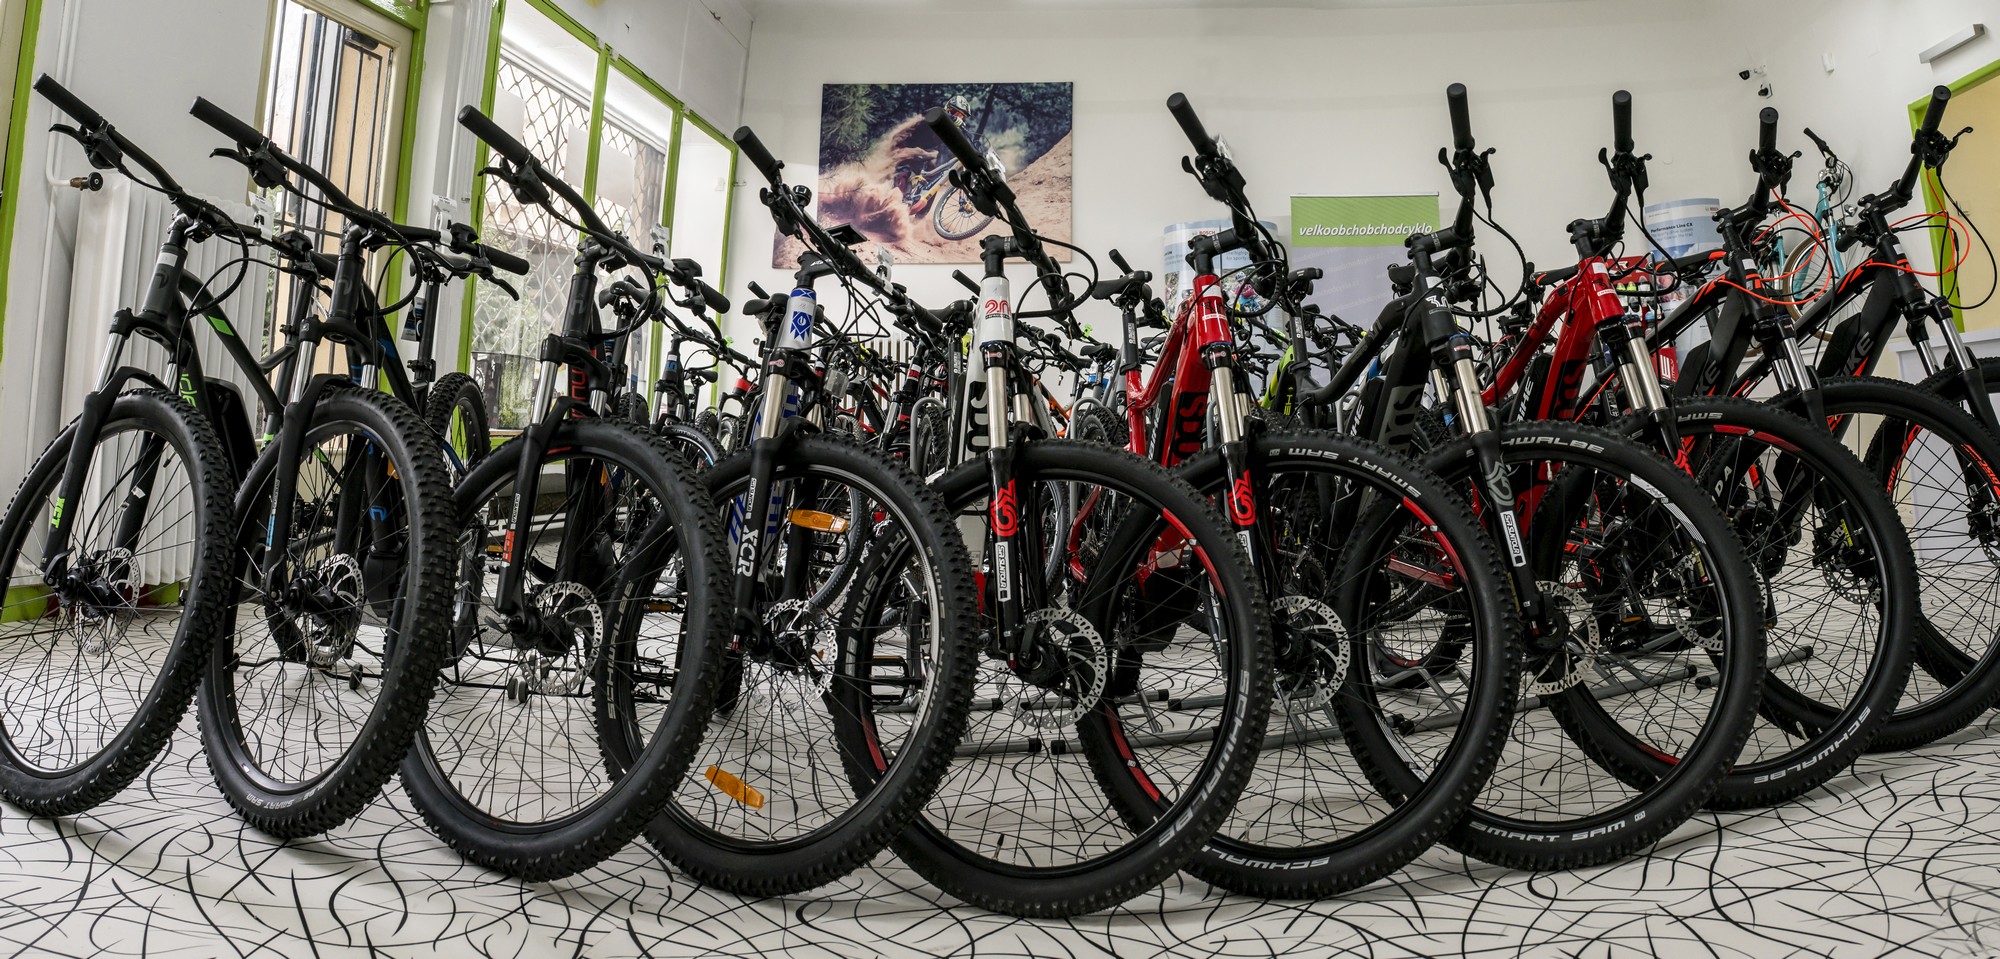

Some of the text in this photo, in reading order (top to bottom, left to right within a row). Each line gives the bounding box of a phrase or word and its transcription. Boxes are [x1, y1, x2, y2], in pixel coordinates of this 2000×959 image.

[1299, 223, 1433, 238] velkoobchobchodcyklo
[1288, 447, 1422, 498] SMART SAM
[51, 497, 66, 529] XCT
[737, 525, 759, 577] XCR
[606, 579, 634, 720] SCHWALBE
[1158, 669, 1250, 847] SCHWALBE
[1753, 705, 1871, 784] SCHWALBE
[1469, 819, 1626, 843] SMART SAM
